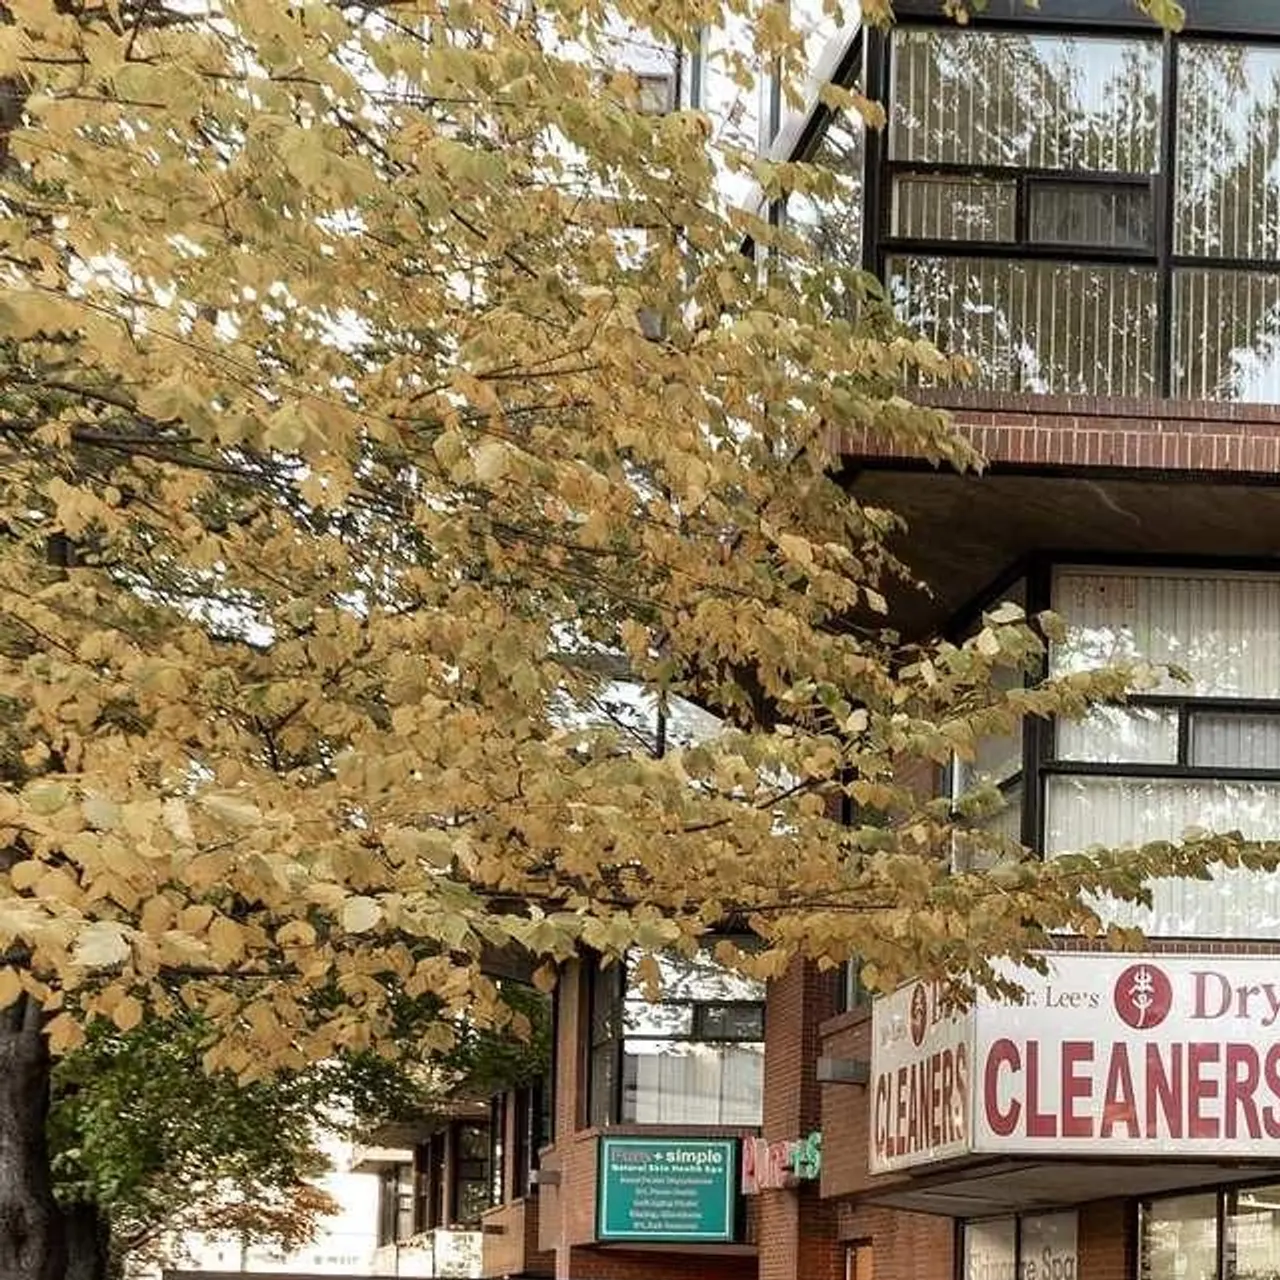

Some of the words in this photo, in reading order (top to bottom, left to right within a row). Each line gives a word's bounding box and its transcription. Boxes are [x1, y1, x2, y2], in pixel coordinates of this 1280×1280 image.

[1046, 986, 1100, 1008] Lee's
[876, 1042, 966, 1158] CLEANERS
[666, 1148, 723, 1165] simple
